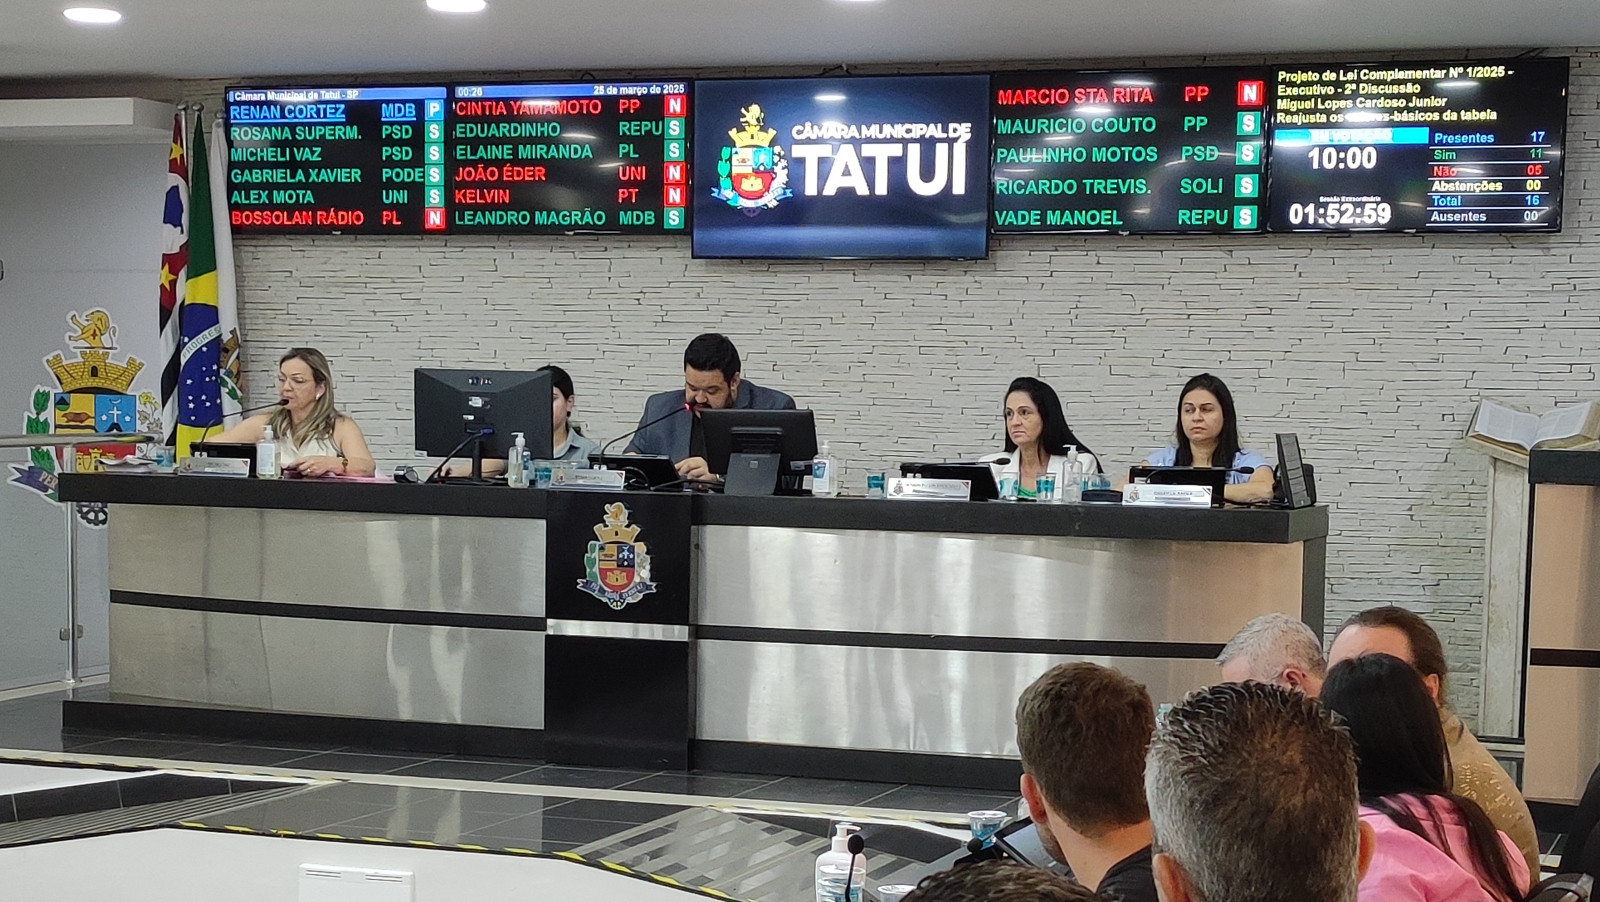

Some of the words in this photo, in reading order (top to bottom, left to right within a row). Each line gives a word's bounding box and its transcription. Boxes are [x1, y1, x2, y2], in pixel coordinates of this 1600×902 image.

[1278, 71, 1320, 84] Projeto
[1322, 70, 1337, 80] de
[1339, 69, 1358, 80] Lei
[1360, 68, 1447, 82] Complementar
[1448, 67, 1464, 79] Nº
[1466, 66, 1505, 78] 1/2025
[235, 91, 266, 100] Câmara
[267, 90, 306, 101] Municipal
[307, 90, 319, 100] de
[347, 90, 359, 99] SP
[606, 86, 618, 95] de
[620, 86, 648, 96] março
[650, 85, 661, 94] de
[663, 84, 685, 93] 2025
[998, 87, 1069, 105] MARCIO
[1074, 87, 1109, 103] STA
[1113, 87, 1153, 103] RITA
[1185, 86, 1209, 102] PP
[1244, 85, 1257, 101] N
[1277, 84, 1335, 96] Executivo
[1359, 83, 1421, 95] Discussão
[230, 105, 281, 119] RENAN
[284, 104, 346, 119] CORTEZ
[381, 103, 416, 117] MDB
[429, 103, 440, 117] P
[456, 101, 507, 116] CINTIA
[510, 100, 602, 115] YAMAMOTO
[619, 100, 641, 114] PP
[669, 100, 680, 113] N
[1277, 98, 1315, 111] Miguel
[1317, 98, 1353, 111] Lopes
[1356, 96, 1406, 109] Cardoso
[1408, 95, 1448, 107] Junior
[997, 118, 1086, 134] MAURICIO
[1091, 117, 1156, 133] COUTO
[1184, 116, 1208, 132] PP
[1243, 115, 1255, 131] S
[1276, 112, 1327, 125] Reajusta
[1329, 114, 1344, 122] os
[1442, 109, 1458, 120] da
[1460, 109, 1498, 120] tabela
[230, 126, 292, 140] ROSANA
[295, 125, 362, 140] SUPERM.
[382, 125, 412, 139] PSD
[429, 124, 440, 138] S
[456, 122, 561, 137] EDUARDINHO
[619, 121, 663, 136] REPU
[669, 121, 680, 136] S
[792, 121, 860, 139] CÂMARA
[861, 123, 947, 139] MUNICIPAL
[948, 123, 972, 139] DE
[1434, 133, 1495, 143] Presentes
[1531, 131, 1545, 142] 17
[230, 147, 290, 161] MICHELI
[294, 147, 322, 161] VAZ
[382, 147, 412, 160] PSD
[429, 146, 440, 160] S
[456, 145, 513, 159] ELAINE
[518, 144, 593, 159] MIRANDA
[619, 144, 639, 158] PL
[669, 144, 680, 158] S
[996, 147, 1087, 163] PAULINHO
[1092, 147, 1158, 162] MOTOS
[1182, 146, 1218, 161] PSD
[1242, 145, 1254, 161] S
[1308, 147, 1377, 169] 10:00
[1433, 149, 1456, 159] Sim
[1530, 148, 1542, 158] 11
[455, 164, 498, 181] JOÃO
[503, 164, 546, 181] ÉDER
[619, 165, 646, 180] UNI
[669, 166, 680, 180] N
[792, 137, 972, 196] TATUÍ
[1433, 166, 1457, 176] Não
[1527, 165, 1542, 175] 05
[231, 169, 305, 183] GABRIELA
[309, 168, 361, 183] XAVIER
[382, 168, 424, 182] PODE
[429, 168, 440, 182] S
[996, 179, 1077, 195] RICARDO
[1083, 179, 1151, 194] TREVIS.
[1180, 178, 1223, 194] SOLI
[1241, 177, 1253, 193] S
[1432, 180, 1503, 192] Abstenções
[1526, 180, 1541, 190] 00
[231, 190, 269, 204] ALEX
[273, 190, 314, 204] MOTA
[382, 190, 408, 204] UNI
[429, 189, 440, 203] S
[455, 189, 510, 204] KELVIN
[618, 189, 639, 203] PT
[669, 188, 680, 202] N
[1432, 196, 1461, 206] Total
[1525, 195, 1540, 205] 16
[232, 211, 312, 225] BOSSOLAN
[317, 207, 364, 225] RÁDIO
[382, 211, 401, 225] PL
[430, 211, 440, 224] N
[455, 211, 530, 225] LEANDRO
[535, 208, 606, 225] MAGRÃO
[619, 211, 655, 225] MDB
[669, 211, 680, 225] S
[995, 210, 1041, 226] VADE
[1047, 210, 1123, 225] MANOEL
[1179, 209, 1228, 225] REPU
[1240, 209, 1252, 225] S
[1289, 203, 1392, 225] 01:52:59
[1431, 211, 1487, 221] Ausentes
[1524, 211, 1538, 221] 00
